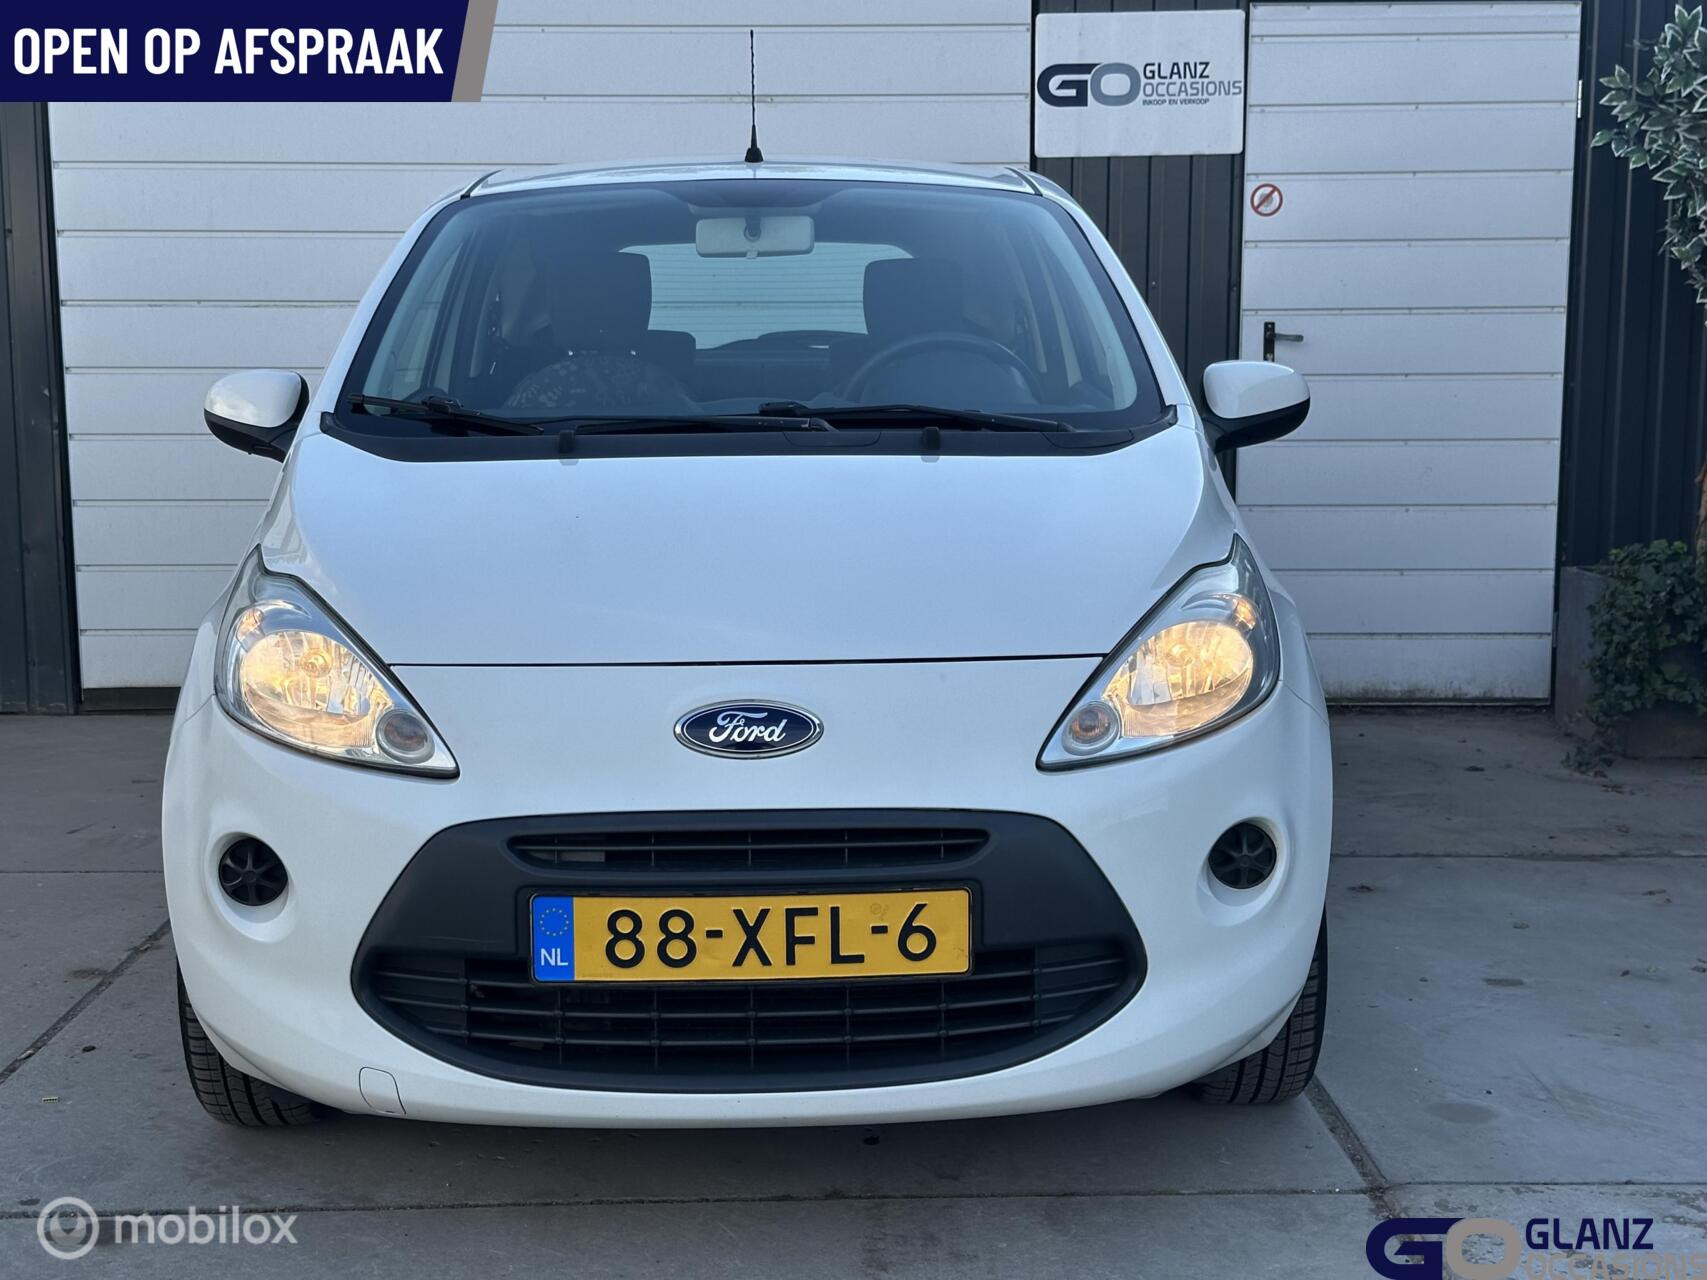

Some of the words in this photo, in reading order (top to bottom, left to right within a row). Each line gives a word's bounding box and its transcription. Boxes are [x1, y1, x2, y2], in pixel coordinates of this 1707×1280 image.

[1143, 62, 1210, 79] GLANZ
[1037, 62, 1141, 107] GO
[1142, 80, 1242, 97] OCCASIONS
[708, 711, 788, 743] Ford
[605, 903, 937, 968] 88-XFL-6
[540, 947, 569, 967] NL
